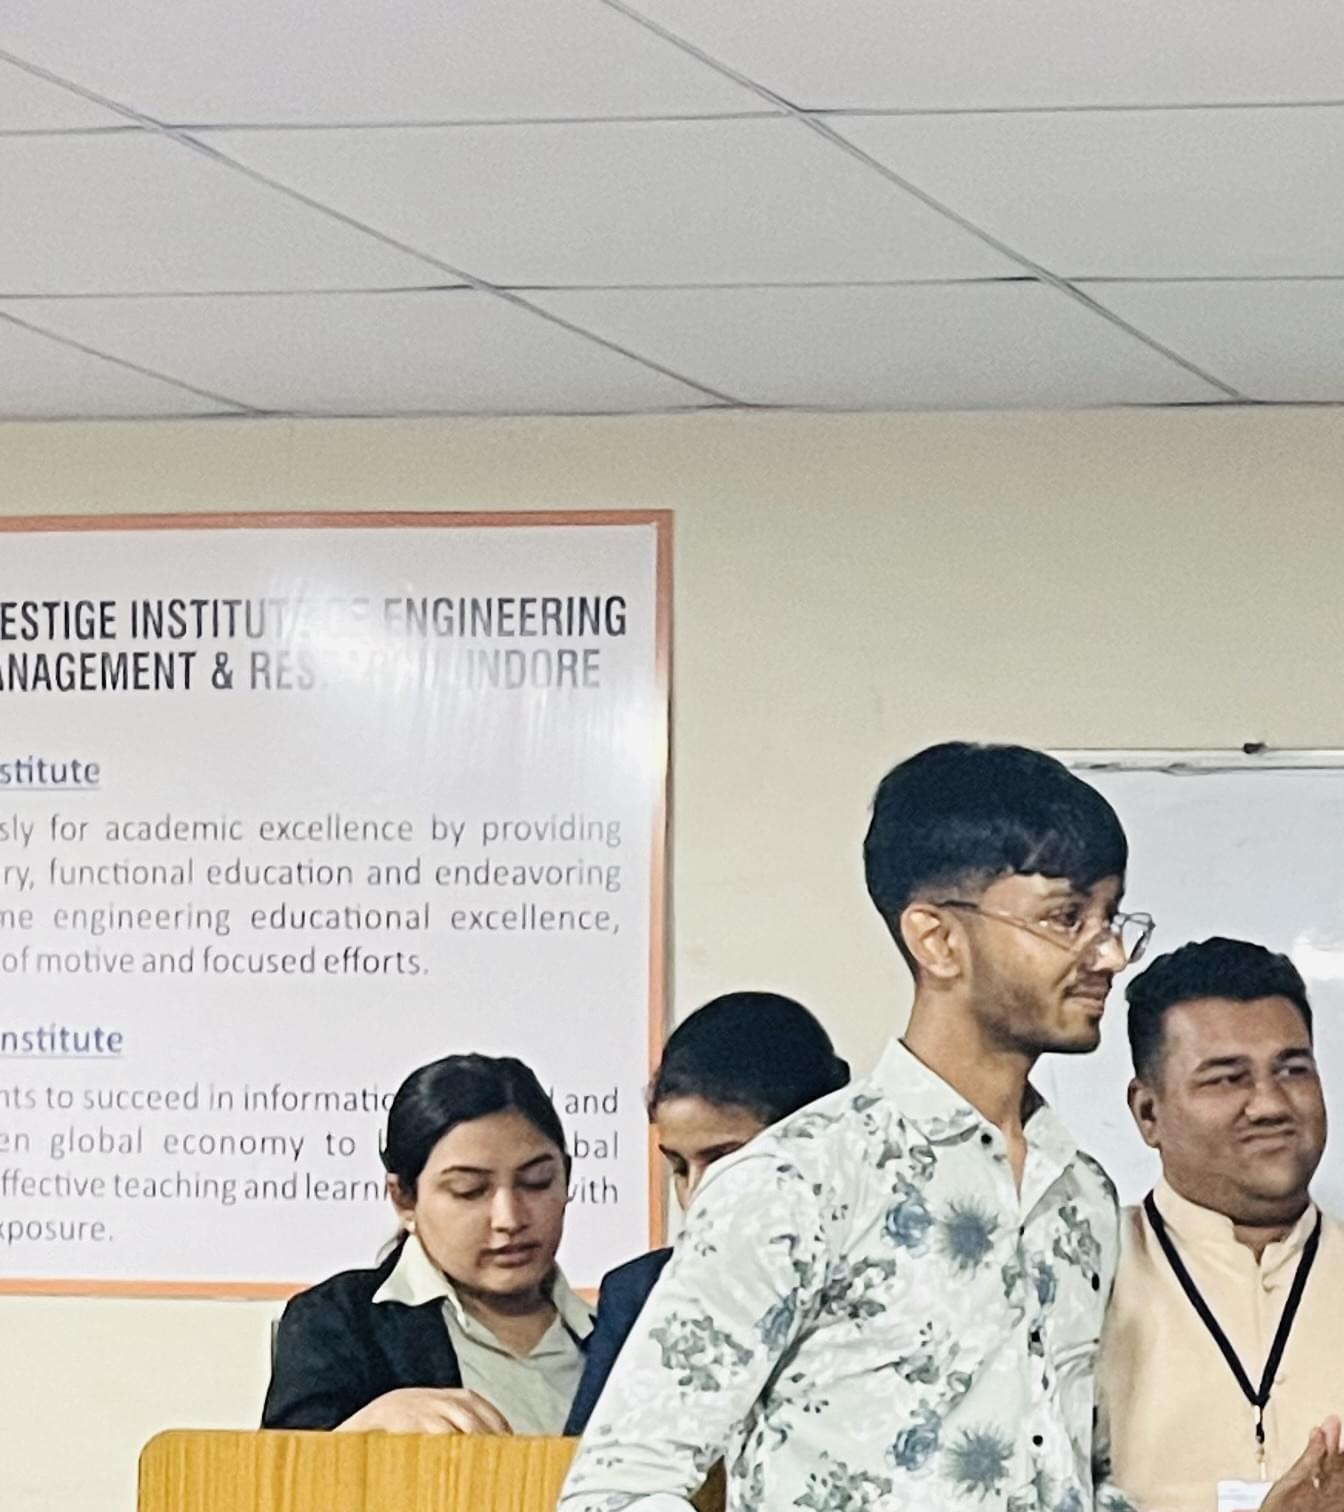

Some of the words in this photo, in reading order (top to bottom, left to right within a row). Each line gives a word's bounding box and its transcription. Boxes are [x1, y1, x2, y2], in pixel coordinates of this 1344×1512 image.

[1, 600, 117, 641] ESTIGE
[131, 598, 305, 639] INSTITUT
[385, 595, 627, 638] ENGINEERING
[0, 651, 196, 692] NAGEMENT
[211, 651, 234, 692] &
[51, 813, 88, 842] for
[106, 813, 243, 842] academic
[259, 813, 412, 842] excellence
[432, 814, 465, 848] by
[483, 813, 621, 848] providing
[50, 857, 193, 886] functional
[207, 857, 353, 888] education
[367, 856, 421, 886] and
[435, 857, 621, 892] endeavoring
[54, 901, 230, 936] engineering
[251, 900, 429, 931] educational
[451, 901, 619, 935] excellence,
[2, 945, 29, 973] of
[37, 946, 134, 974] motive
[142, 945, 194, 974] and
[203, 945, 315, 975] focused
[324, 945, 429, 976] efforts.
[1, 1022, 124, 1055] nstitute
[46, 1086, 73, 1109] to
[84, 1082, 199, 1111] succeed
[209, 1083, 233, 1112] in
[244, 1082, 395, 1113] informatio
[565, 1086, 618, 1115] and
[51, 1125, 142, 1160] global
[164, 1133, 304, 1162] economy
[326, 1131, 356, 1157] to
[574, 1130, 618, 1160] bal
[2, 1167, 105, 1197] ffective
[114, 1170, 236, 1205] teaching
[244, 1171, 298, 1201] and
